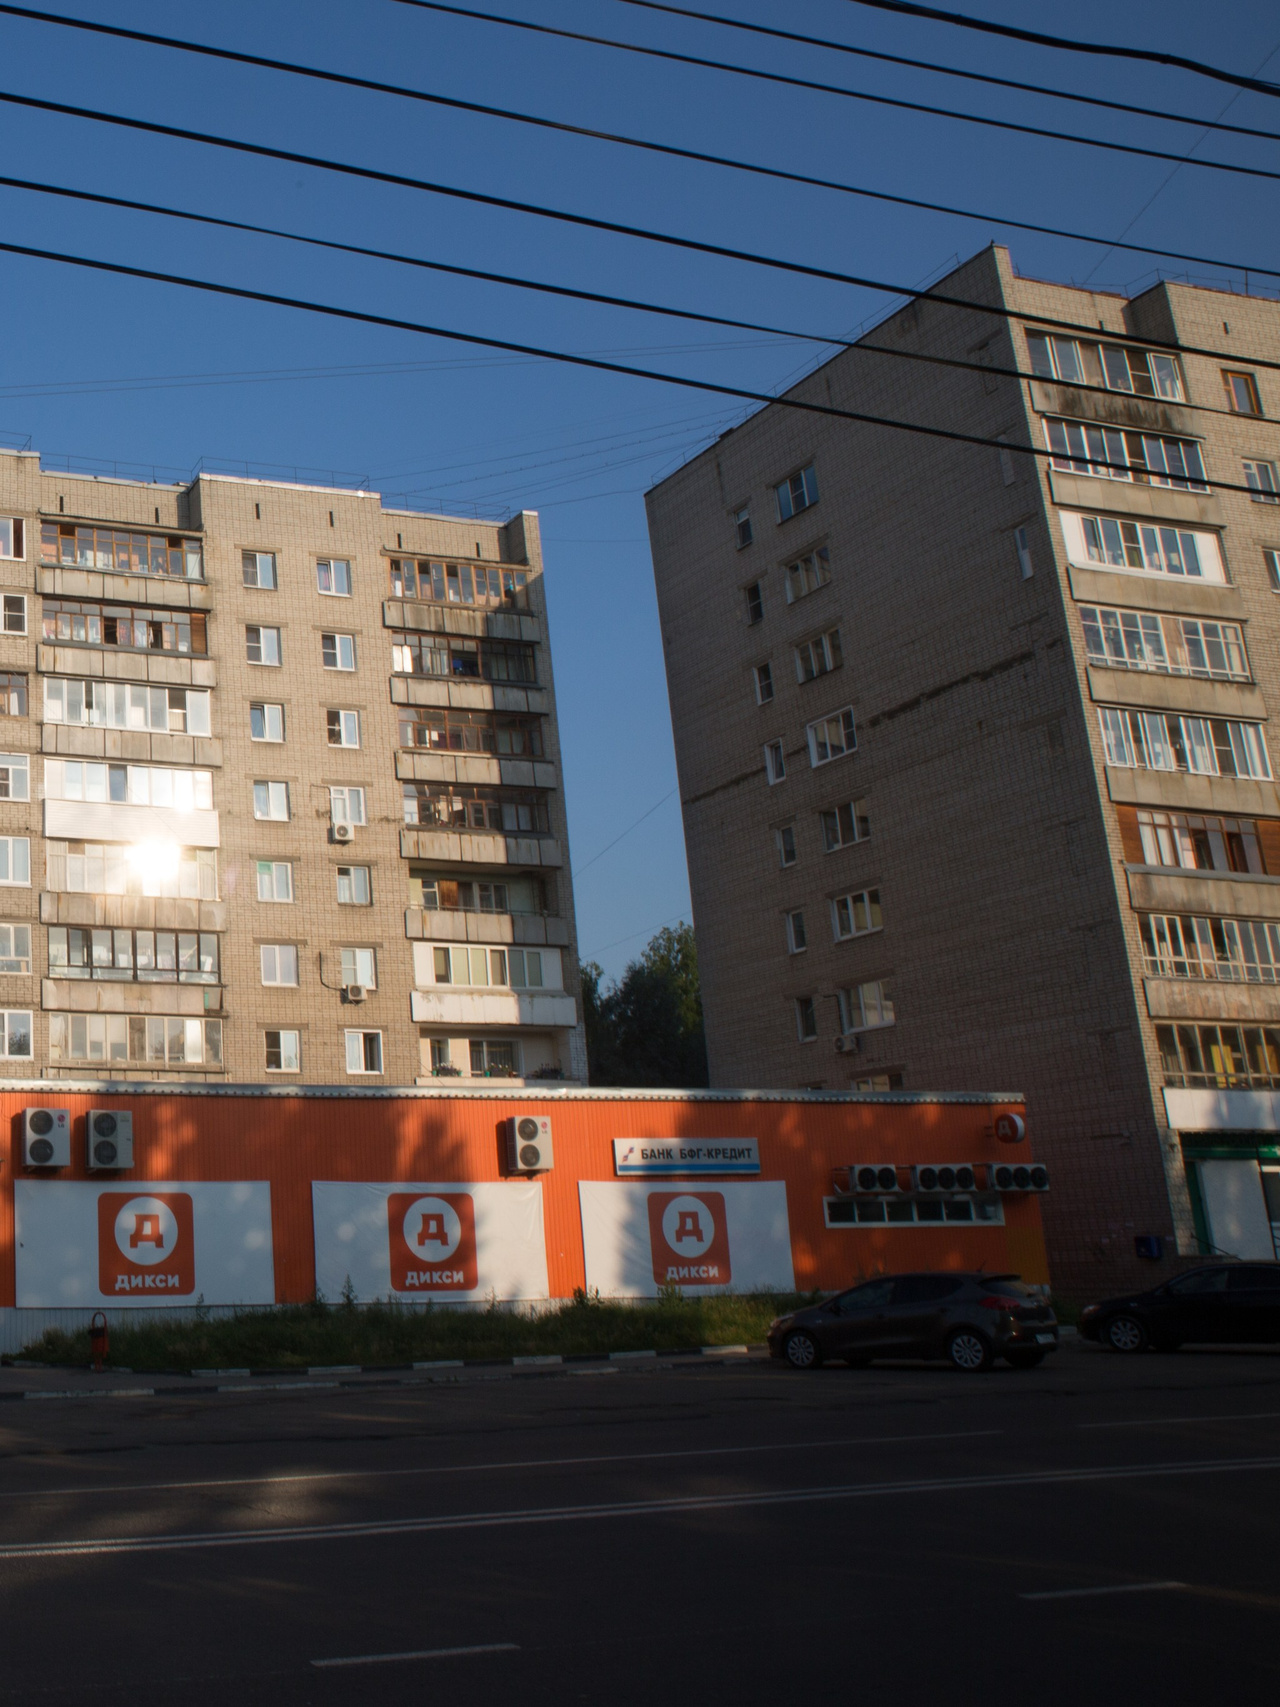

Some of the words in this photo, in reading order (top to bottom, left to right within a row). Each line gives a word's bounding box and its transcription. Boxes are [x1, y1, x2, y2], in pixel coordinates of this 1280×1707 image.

[641, 1148, 673, 1160] БАНК
[679, 1148, 752, 1161] БФГ-КРЕДИТ
[405, 1270, 464, 1287] ДИКСИ
[666, 1265, 719, 1280] ДИКСИ
[115, 1273, 180, 1291] ДИКСИ
